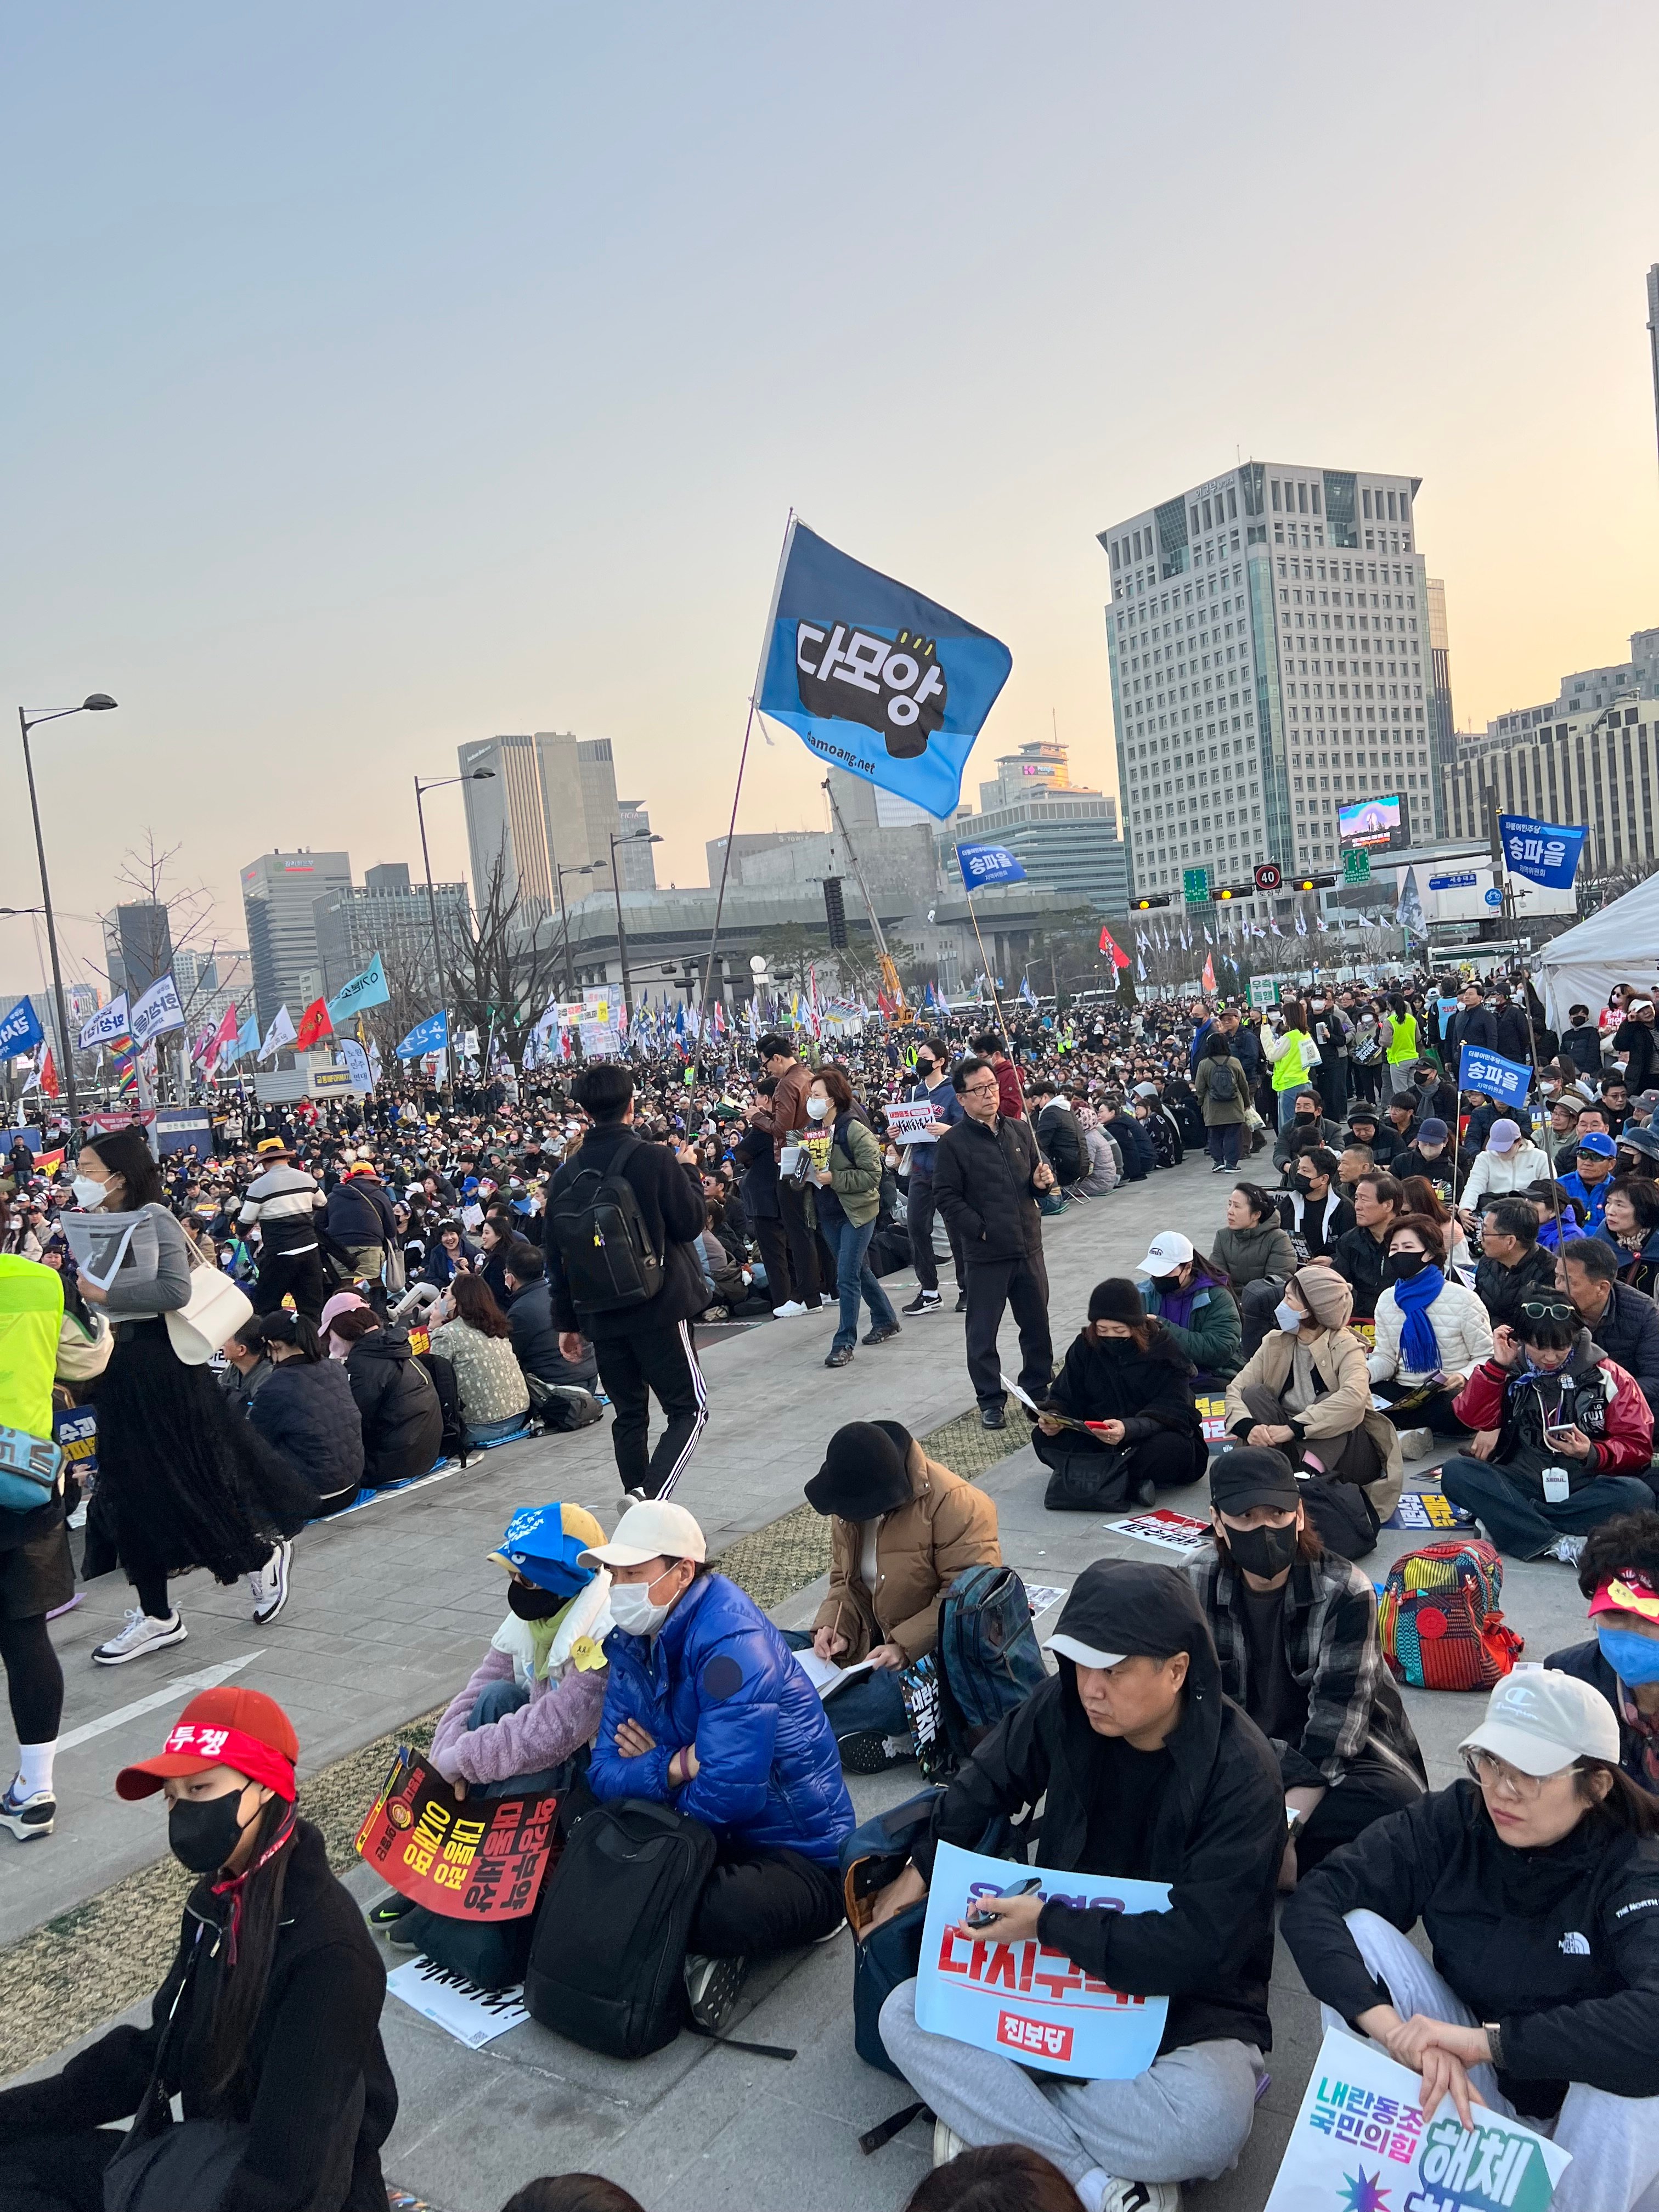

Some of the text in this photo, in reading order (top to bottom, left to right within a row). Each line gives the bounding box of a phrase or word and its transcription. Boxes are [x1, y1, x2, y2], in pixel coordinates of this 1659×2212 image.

[1196, 481, 1216, 499] 외교부
[797, 622, 944, 726] 다모앙
[807, 730, 876, 775] damoang.net
[1505, 822, 1541, 834] 더불어민주당
[969, 853, 1012, 875] 송파을
[1510, 836, 1566, 867] 송파을
[1261, 871, 1274, 883] 40
[1450, 874, 1475, 883] 세종대로
[1252, 979, 1272, 990] 우측
[1253, 991, 1273, 1002] 통행
[1468, 1051, 1502, 1064] 더불어민주당
[327, 1073, 350, 1082] INFORMATI
[353, 1072, 368, 1081] 연대
[1468, 1061, 1519, 1092] 송파을
[1476, 1082, 1504, 1095] 지역위원회
[1583, 1409, 1605, 1423] TWI
[1397, 1494, 1431, 1527] 내란수괴
[911, 1678, 939, 1713] 내란수
[170, 1725, 229, 1756] 투쟁
[403, 1801, 450, 1877] 이재명
[433, 1818, 486, 1891] 대통령
[500, 1798, 557, 1911] 억강부약
[463, 1801, 524, 1913] 대동세상
[1629, 1898, 1658, 1911] NORTH
[1005, 2016, 1066, 2054] 진보당
[1317, 2076, 1425, 2136] 내란동조
[1309, 2104, 1418, 2165] 국민의힘
[1426, 2126, 1534, 2208] 해체
